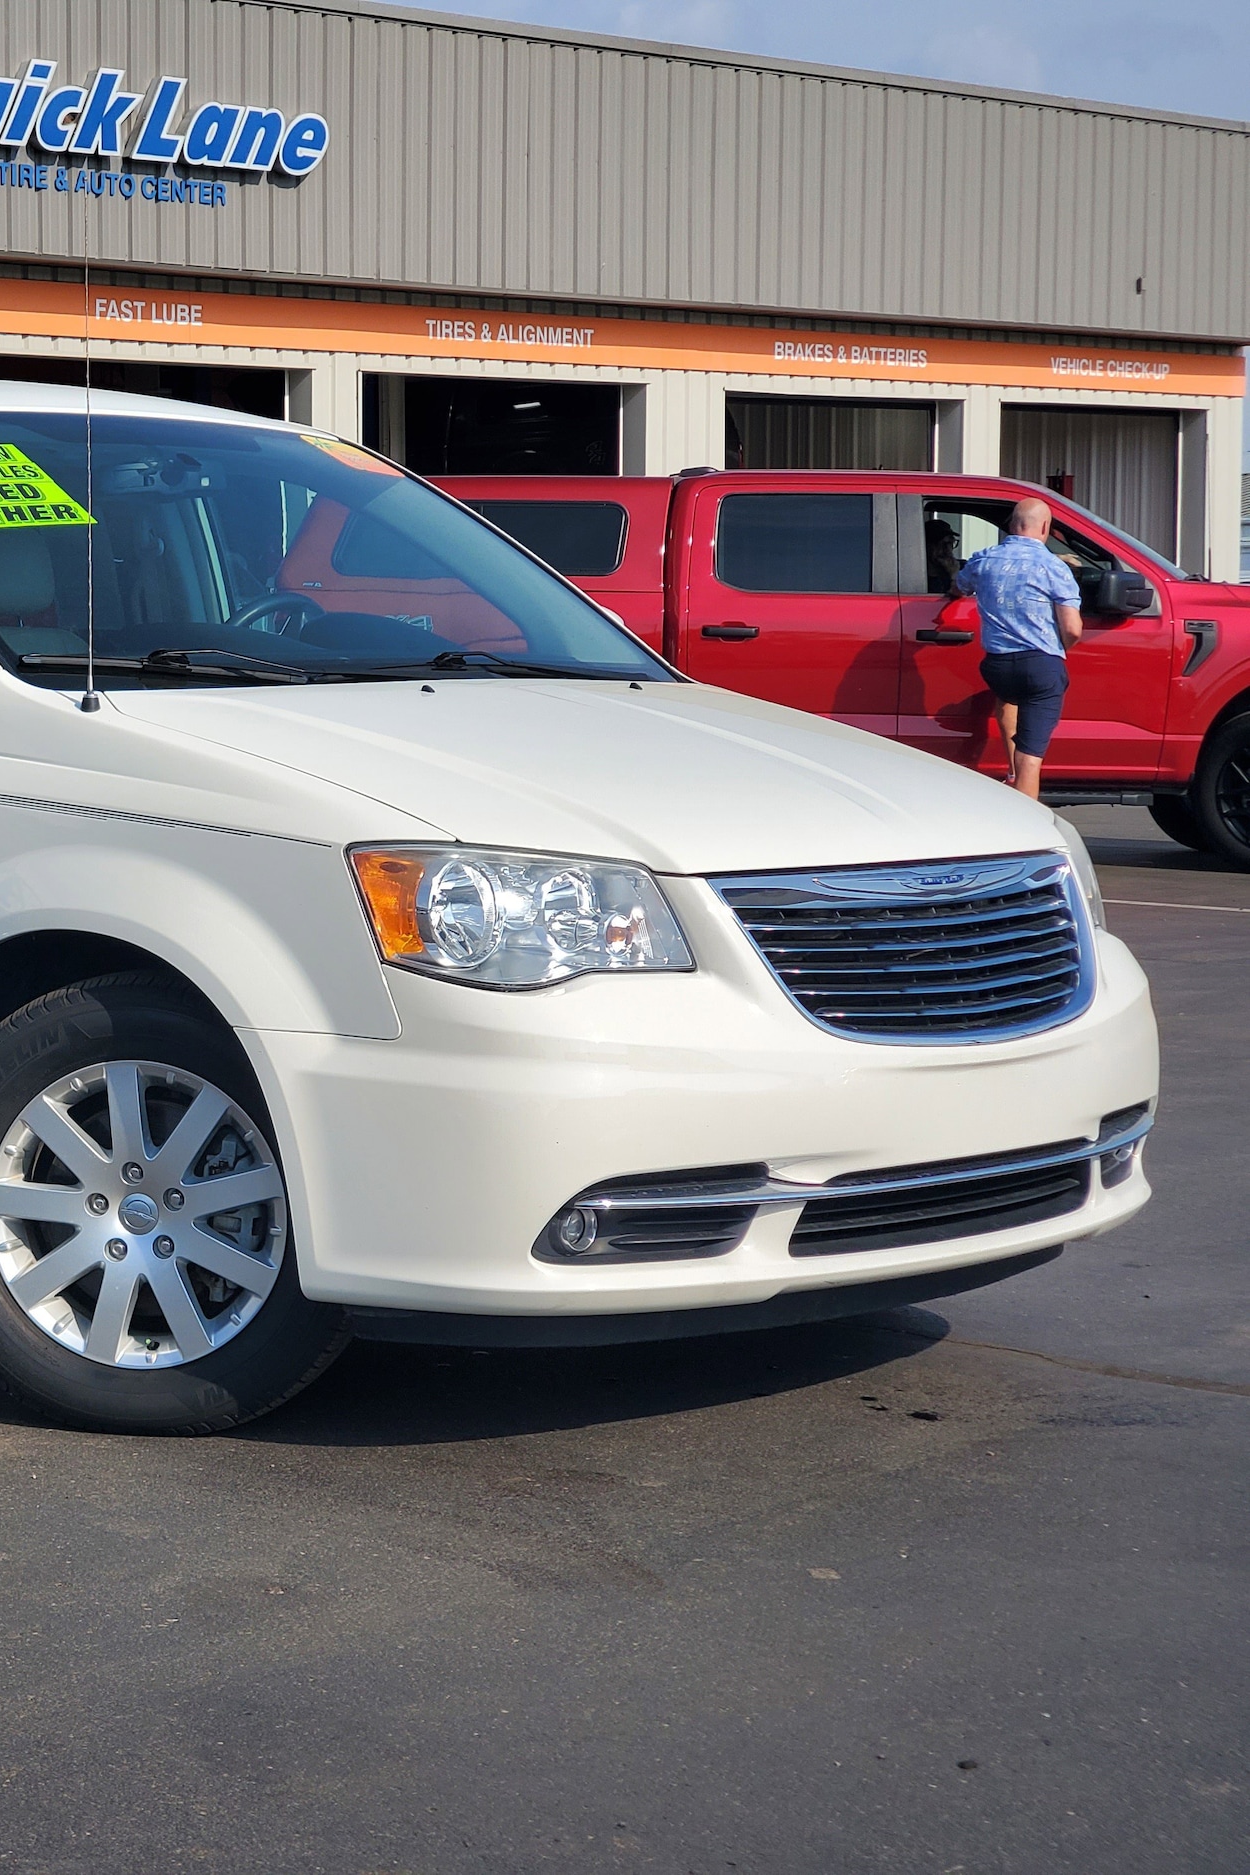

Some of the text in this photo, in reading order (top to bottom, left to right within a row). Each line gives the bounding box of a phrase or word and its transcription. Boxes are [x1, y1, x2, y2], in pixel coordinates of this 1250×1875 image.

[132, 75, 330, 176] Lane
[53, 167, 69, 191] &
[75, 170, 136, 199] AUTO
[141, 176, 227, 206] CENTER
[95, 298, 203, 326] FAST LUBE
[425, 319, 594, 348] TIRES & ALIGNMENT
[774, 341, 928, 368] BRAKES & BATTERIES
[1051, 357, 1170, 380] VEHICLE CHECK-UP
